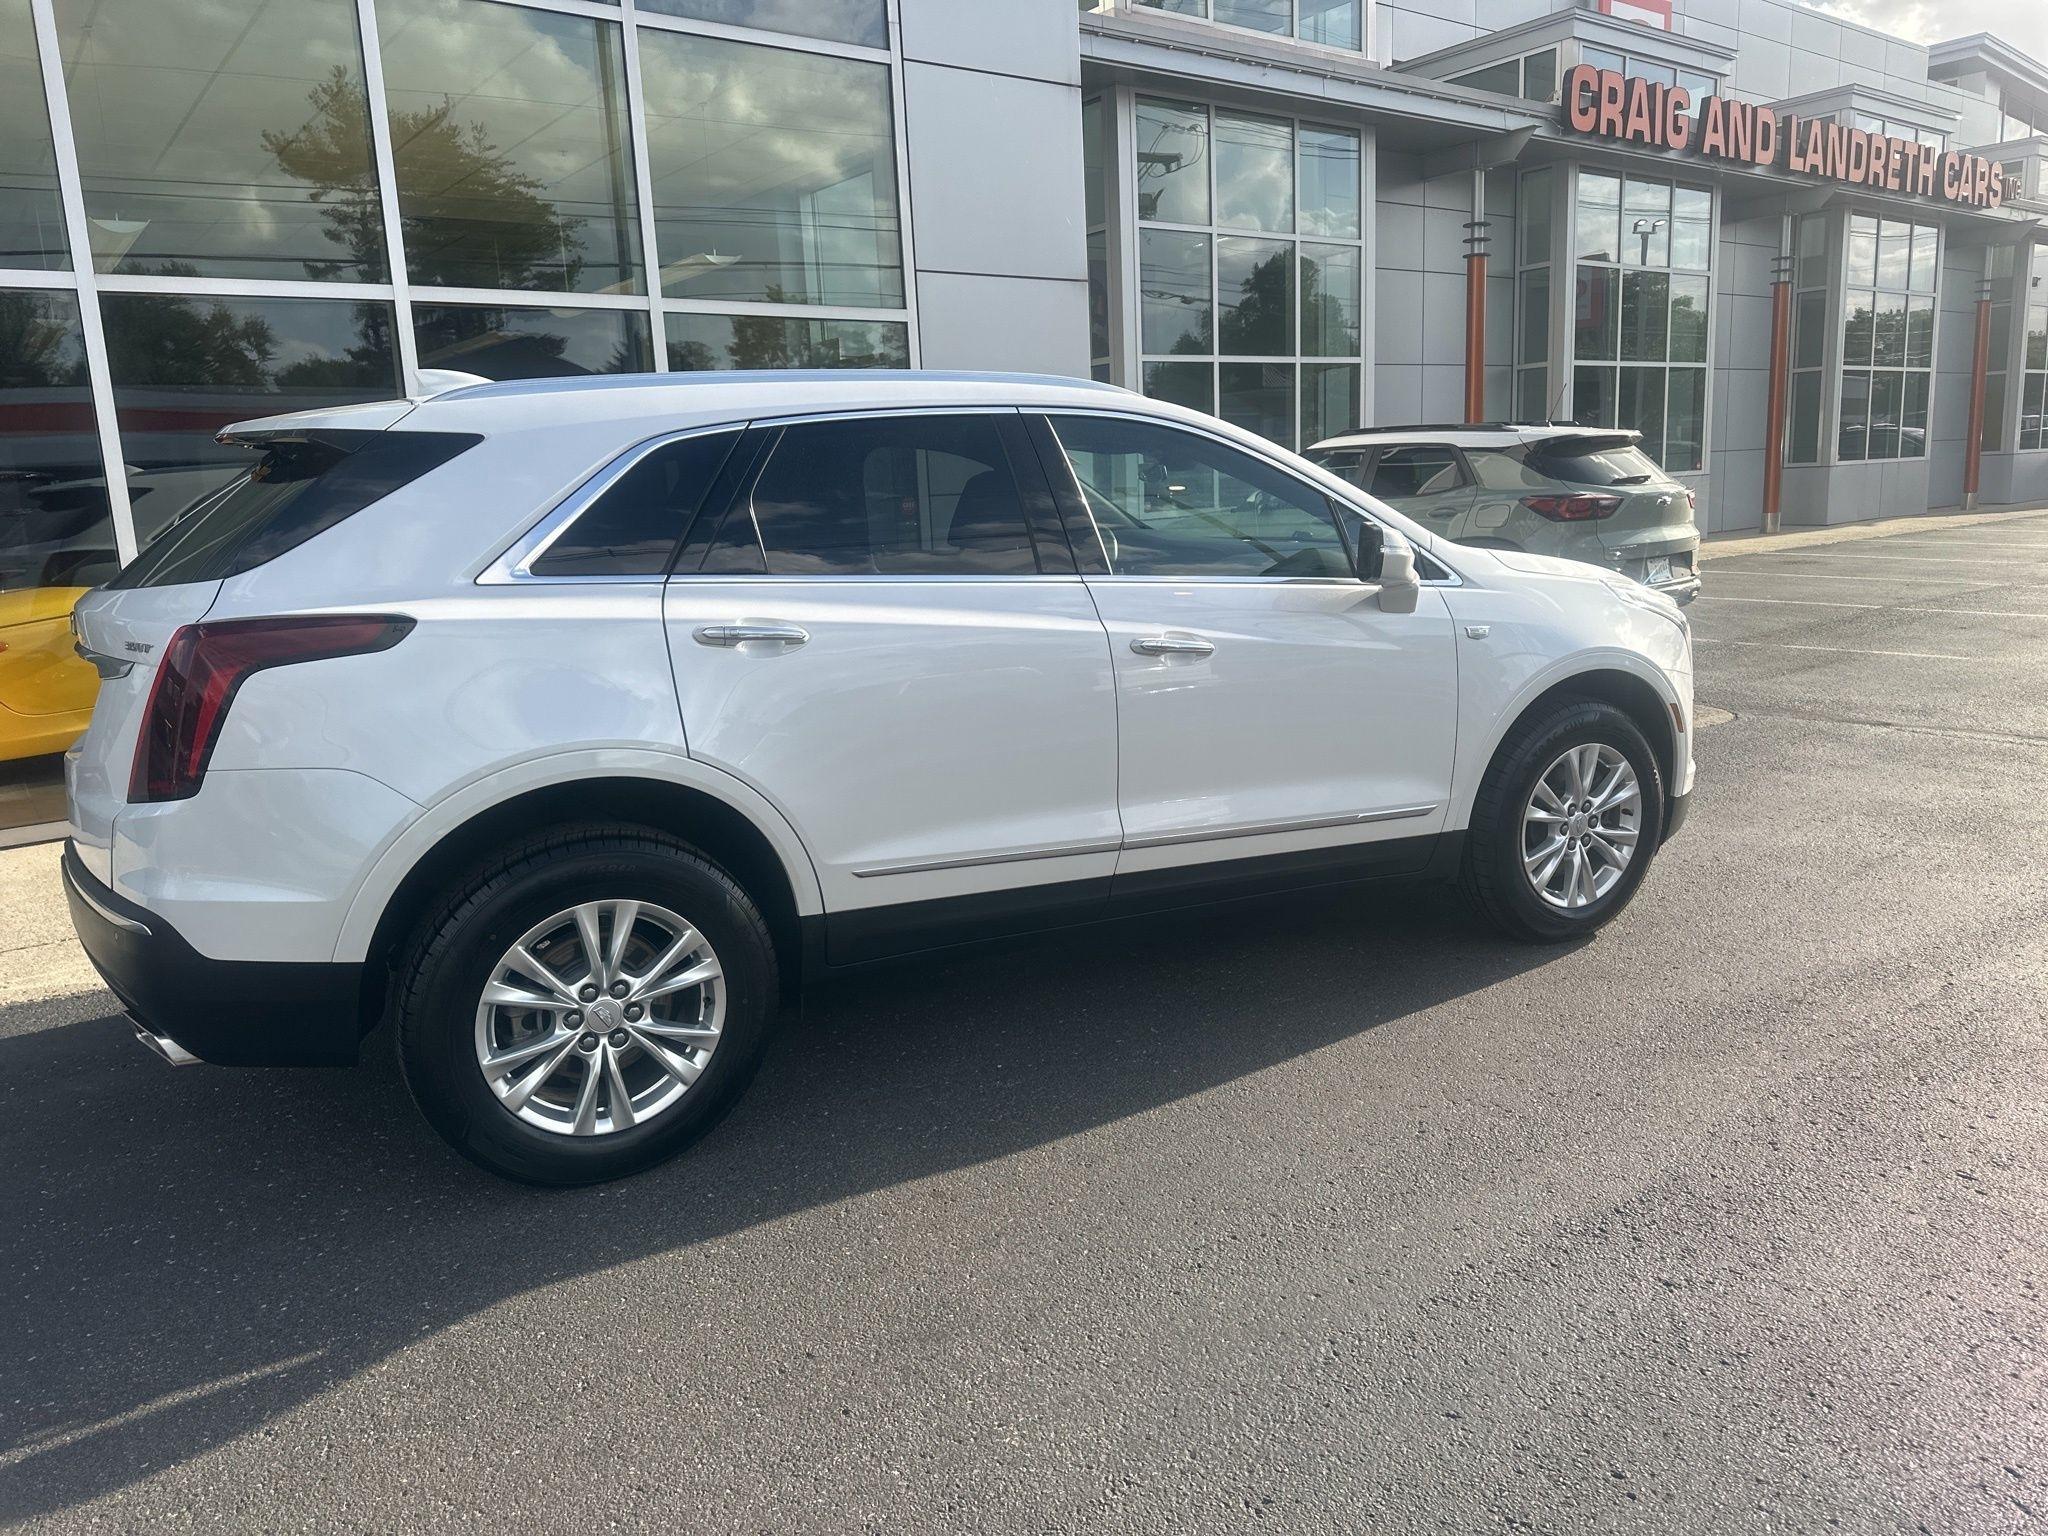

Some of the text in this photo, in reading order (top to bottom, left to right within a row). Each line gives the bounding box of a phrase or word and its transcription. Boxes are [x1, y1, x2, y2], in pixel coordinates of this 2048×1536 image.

[1565, 63, 1691, 150] CRAIG
[1700, 95, 1777, 165] AND
[1785, 113, 1936, 196] LANDRETH
[1940, 150, 2003, 209] CARS
